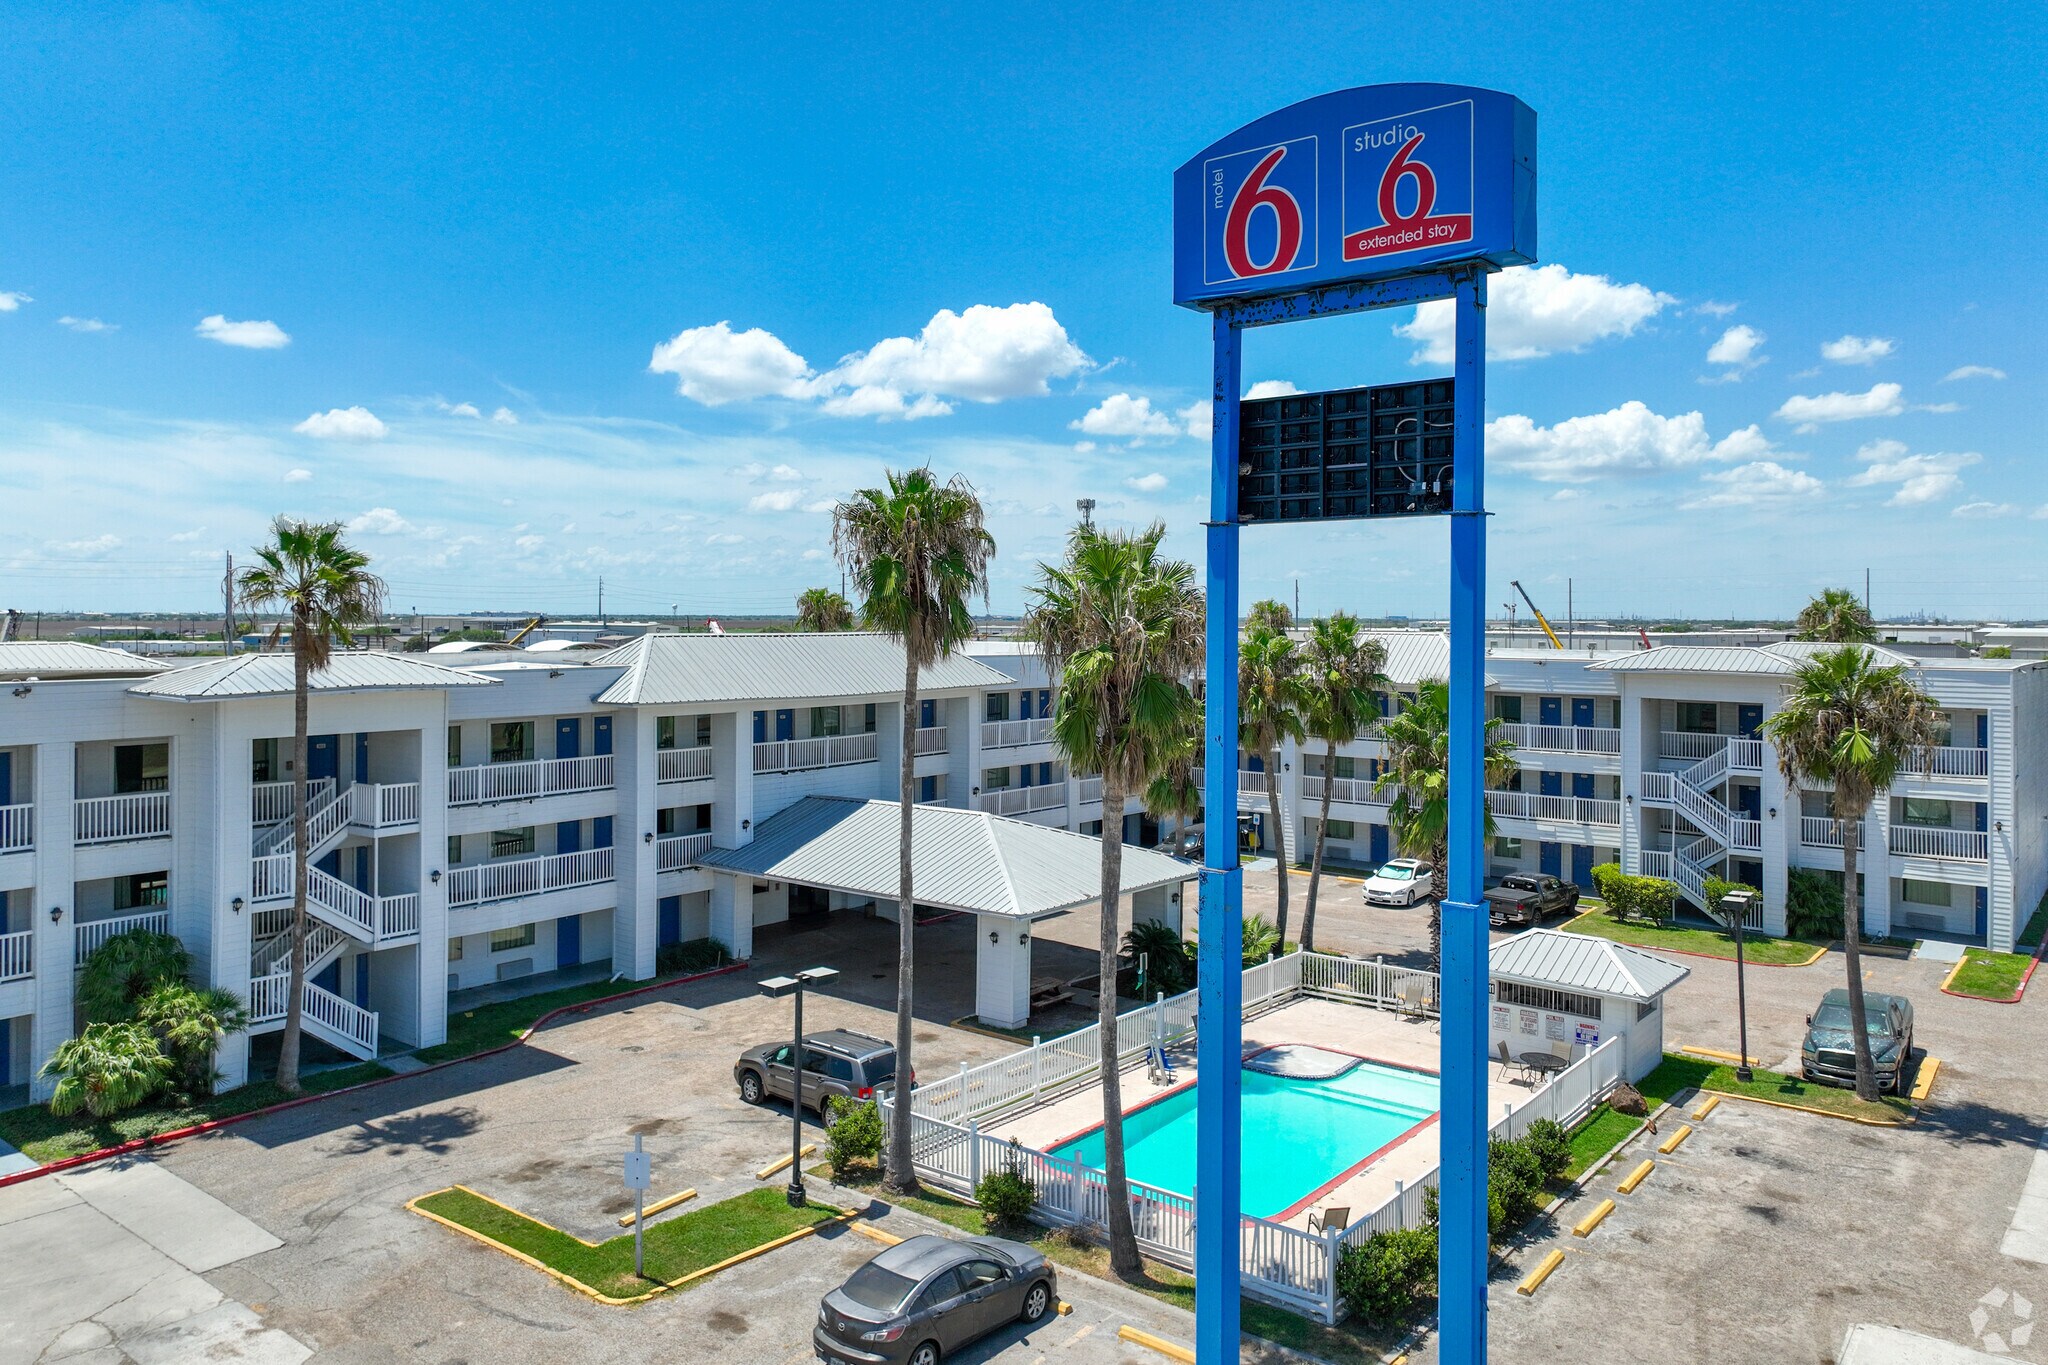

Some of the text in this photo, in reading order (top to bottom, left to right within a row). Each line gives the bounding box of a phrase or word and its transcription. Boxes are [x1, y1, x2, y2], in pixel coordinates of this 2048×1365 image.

[1354, 123, 1419, 152] studio
[1212, 168, 1224, 209] motel
[1377, 132, 1437, 225] 6
[1223, 145, 1303, 279] 6
[1358, 223, 1458, 251] extended stay
